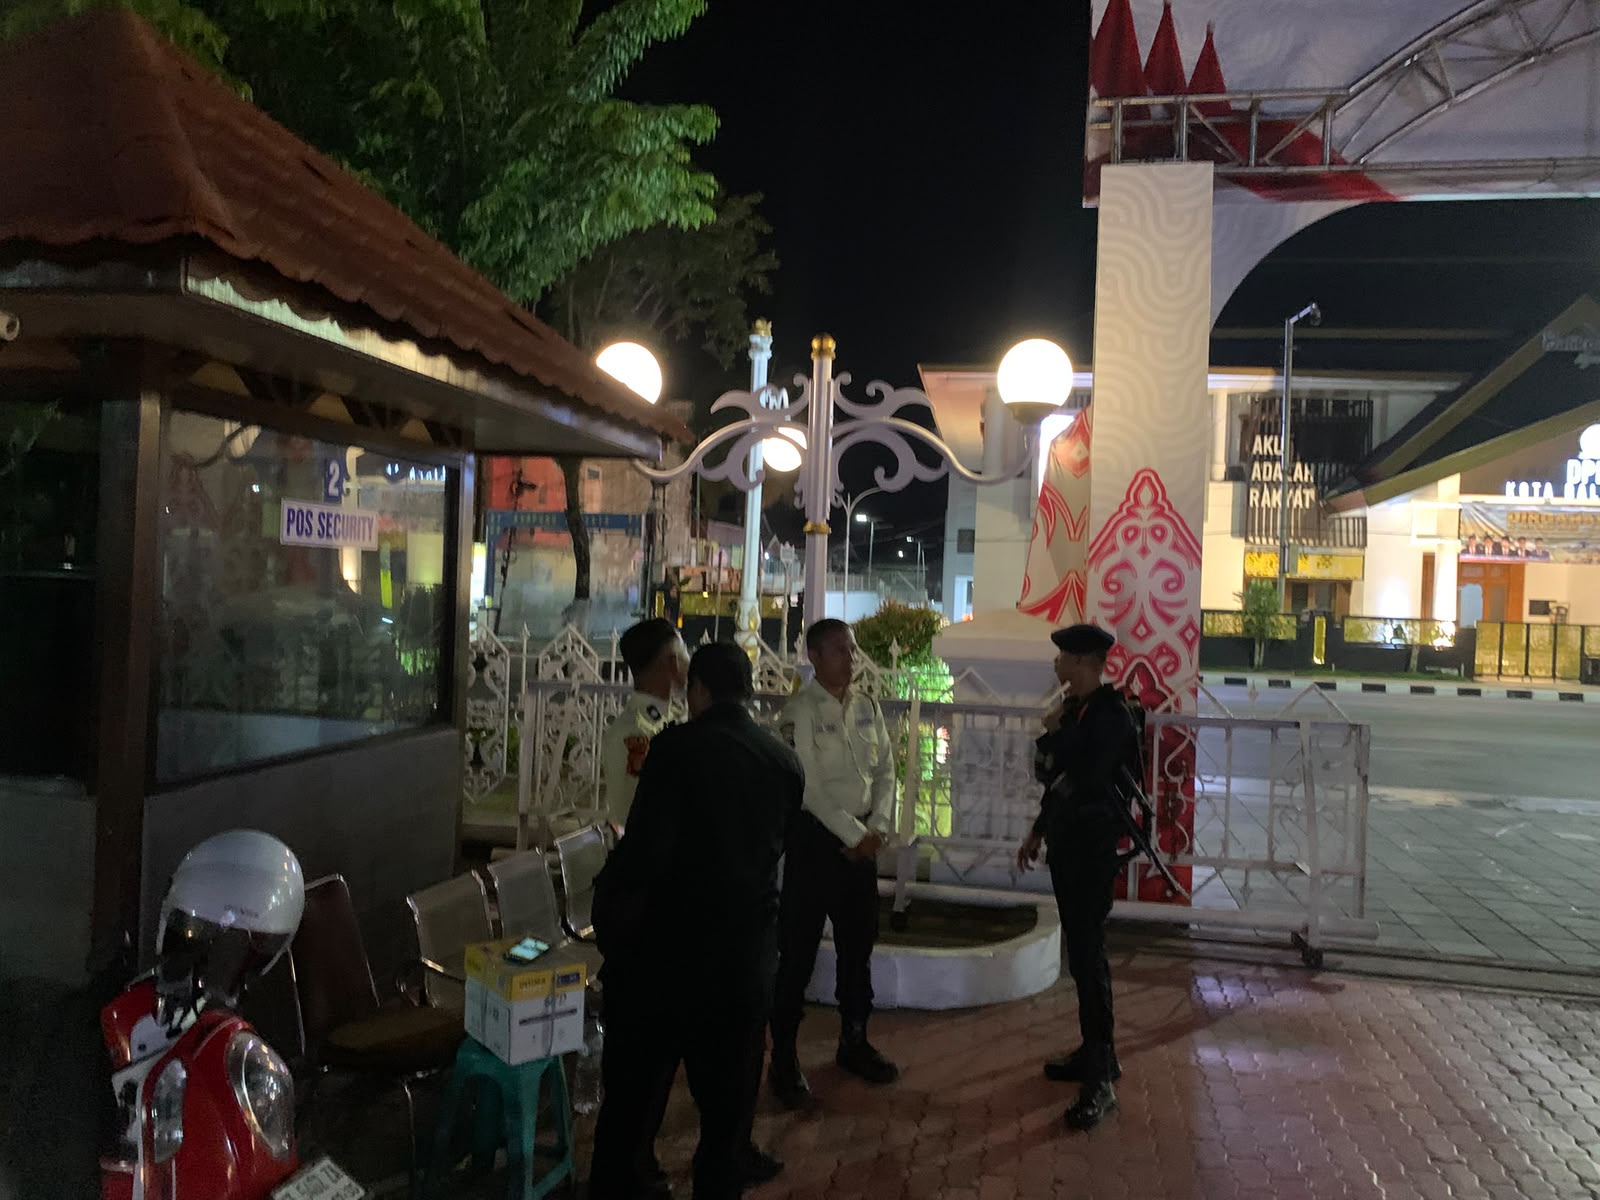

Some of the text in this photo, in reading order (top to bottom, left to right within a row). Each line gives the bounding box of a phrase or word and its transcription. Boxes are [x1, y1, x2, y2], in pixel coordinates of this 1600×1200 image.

[328, 461, 340, 497] 2
[1506, 481, 1554, 498] KOTA
[286, 508, 374, 542] POS SECURITY
